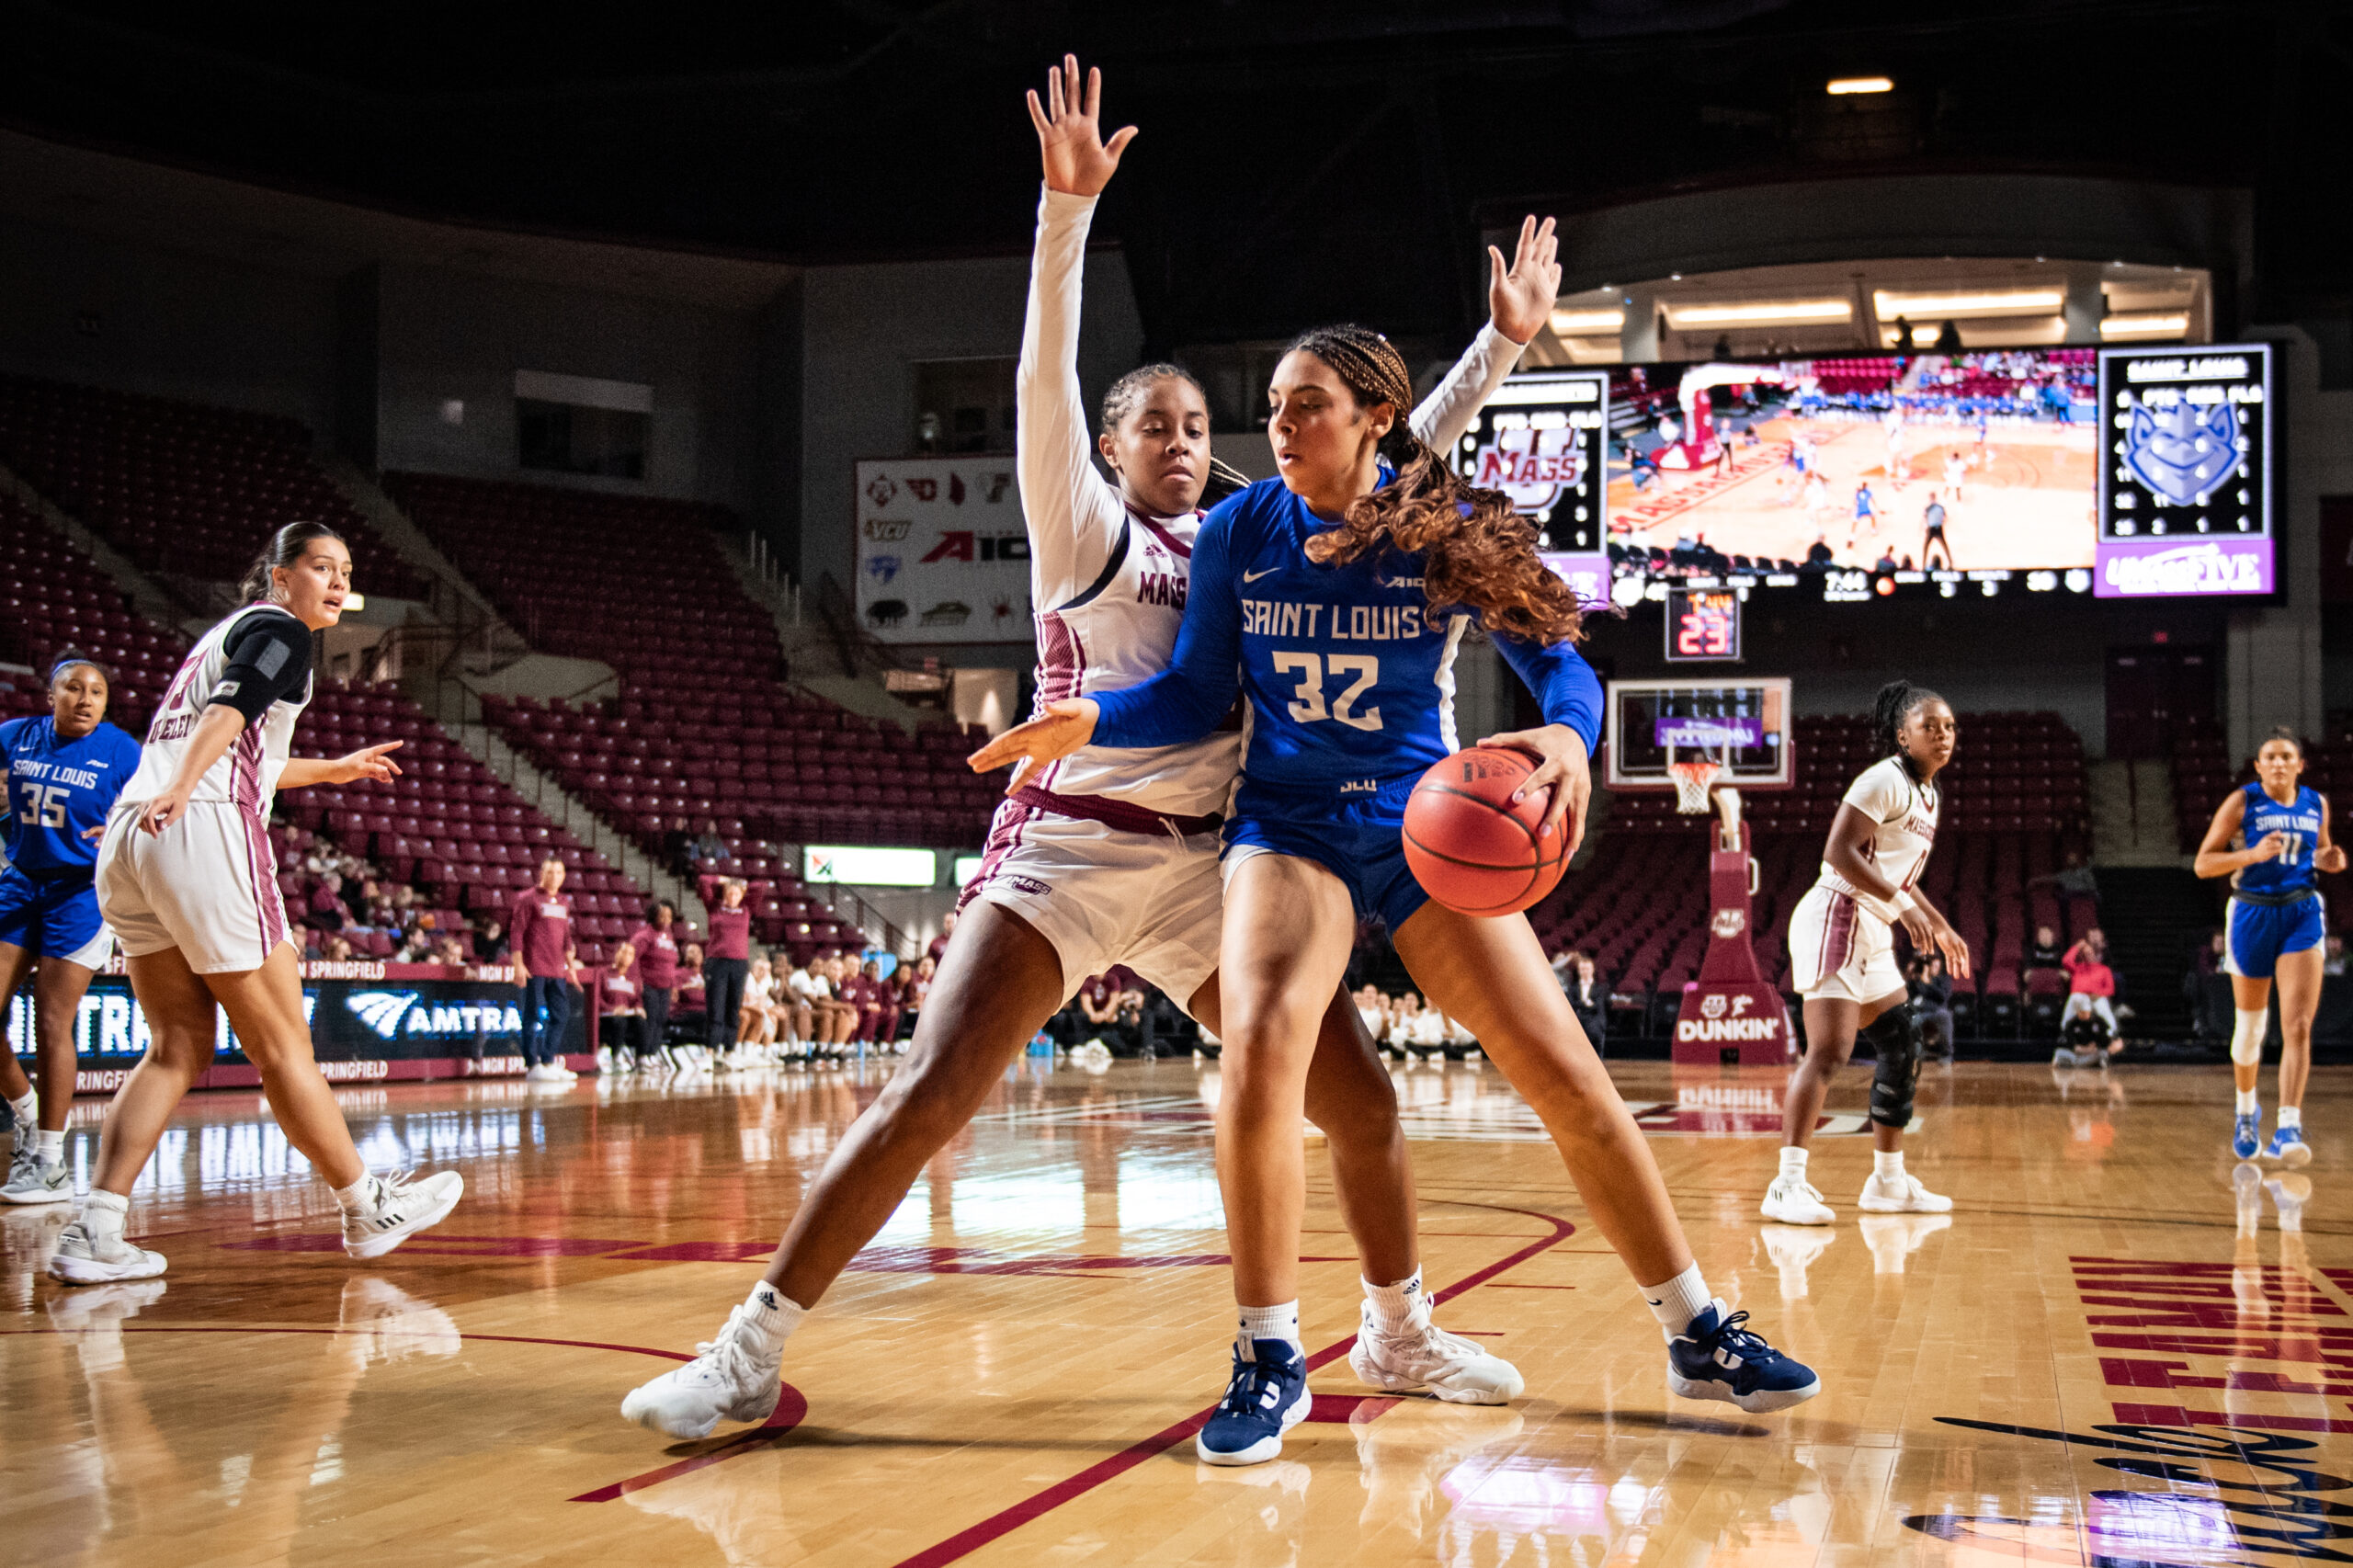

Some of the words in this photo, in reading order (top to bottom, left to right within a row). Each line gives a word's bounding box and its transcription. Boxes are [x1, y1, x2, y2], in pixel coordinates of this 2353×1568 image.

[1242, 599, 1323, 637] SAINT
[1331, 605, 1420, 640] LOUIS
[1678, 614, 1730, 654] 23
[1272, 651, 1383, 732] 32
[12, 759, 52, 779] SAINT
[51, 766, 98, 790] LOUIS
[20, 782, 71, 828] 35
[2255, 814, 2290, 832] SAINT
[2279, 831, 2302, 866] 11
[1011, 875, 1052, 895] MASS
[310, 960, 386, 980] SPRINGFIELD
[405, 1006, 526, 1033] AMTRA
[1678, 1017, 1779, 1042] DUNKIN'
